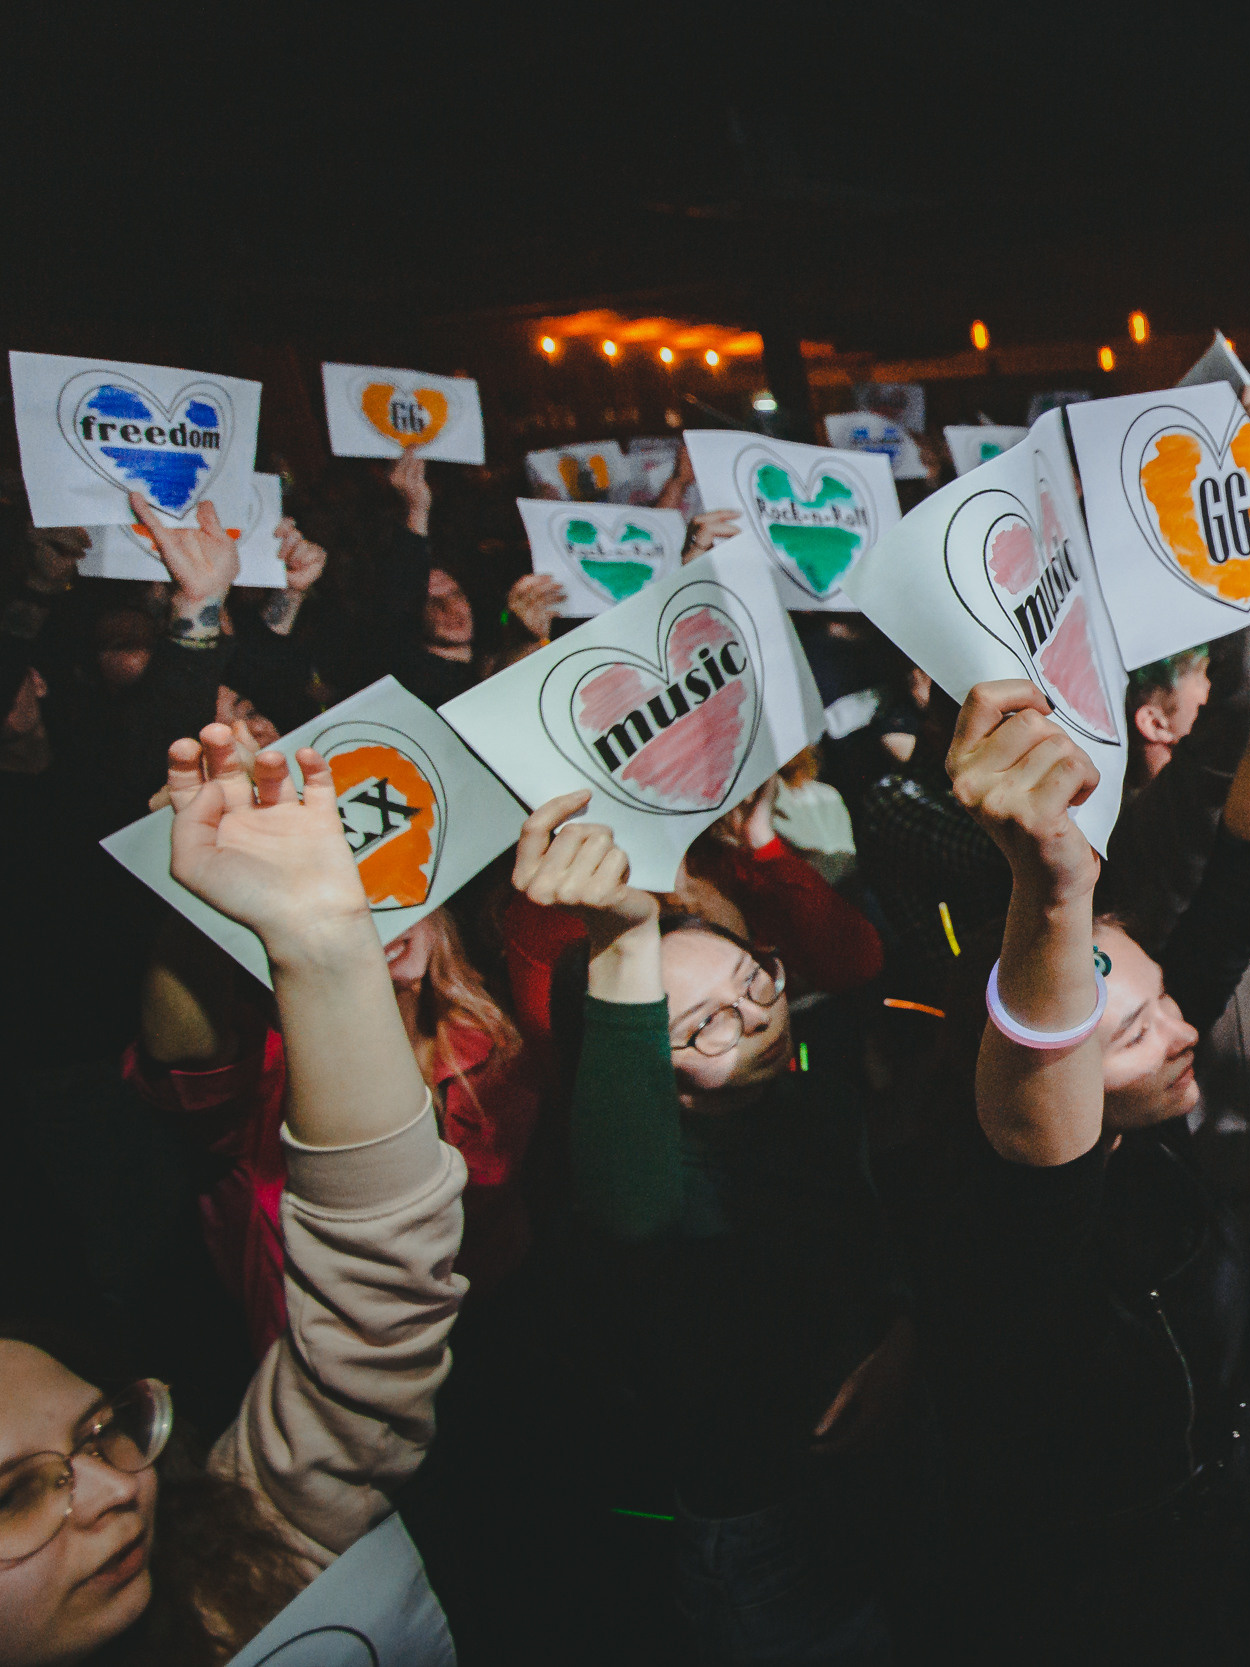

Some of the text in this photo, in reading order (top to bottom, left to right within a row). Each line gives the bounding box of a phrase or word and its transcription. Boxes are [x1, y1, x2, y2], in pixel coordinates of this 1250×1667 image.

[80, 415, 220, 449] freedom
[1013, 535, 1080, 658] music
[593, 640, 747, 773] music
